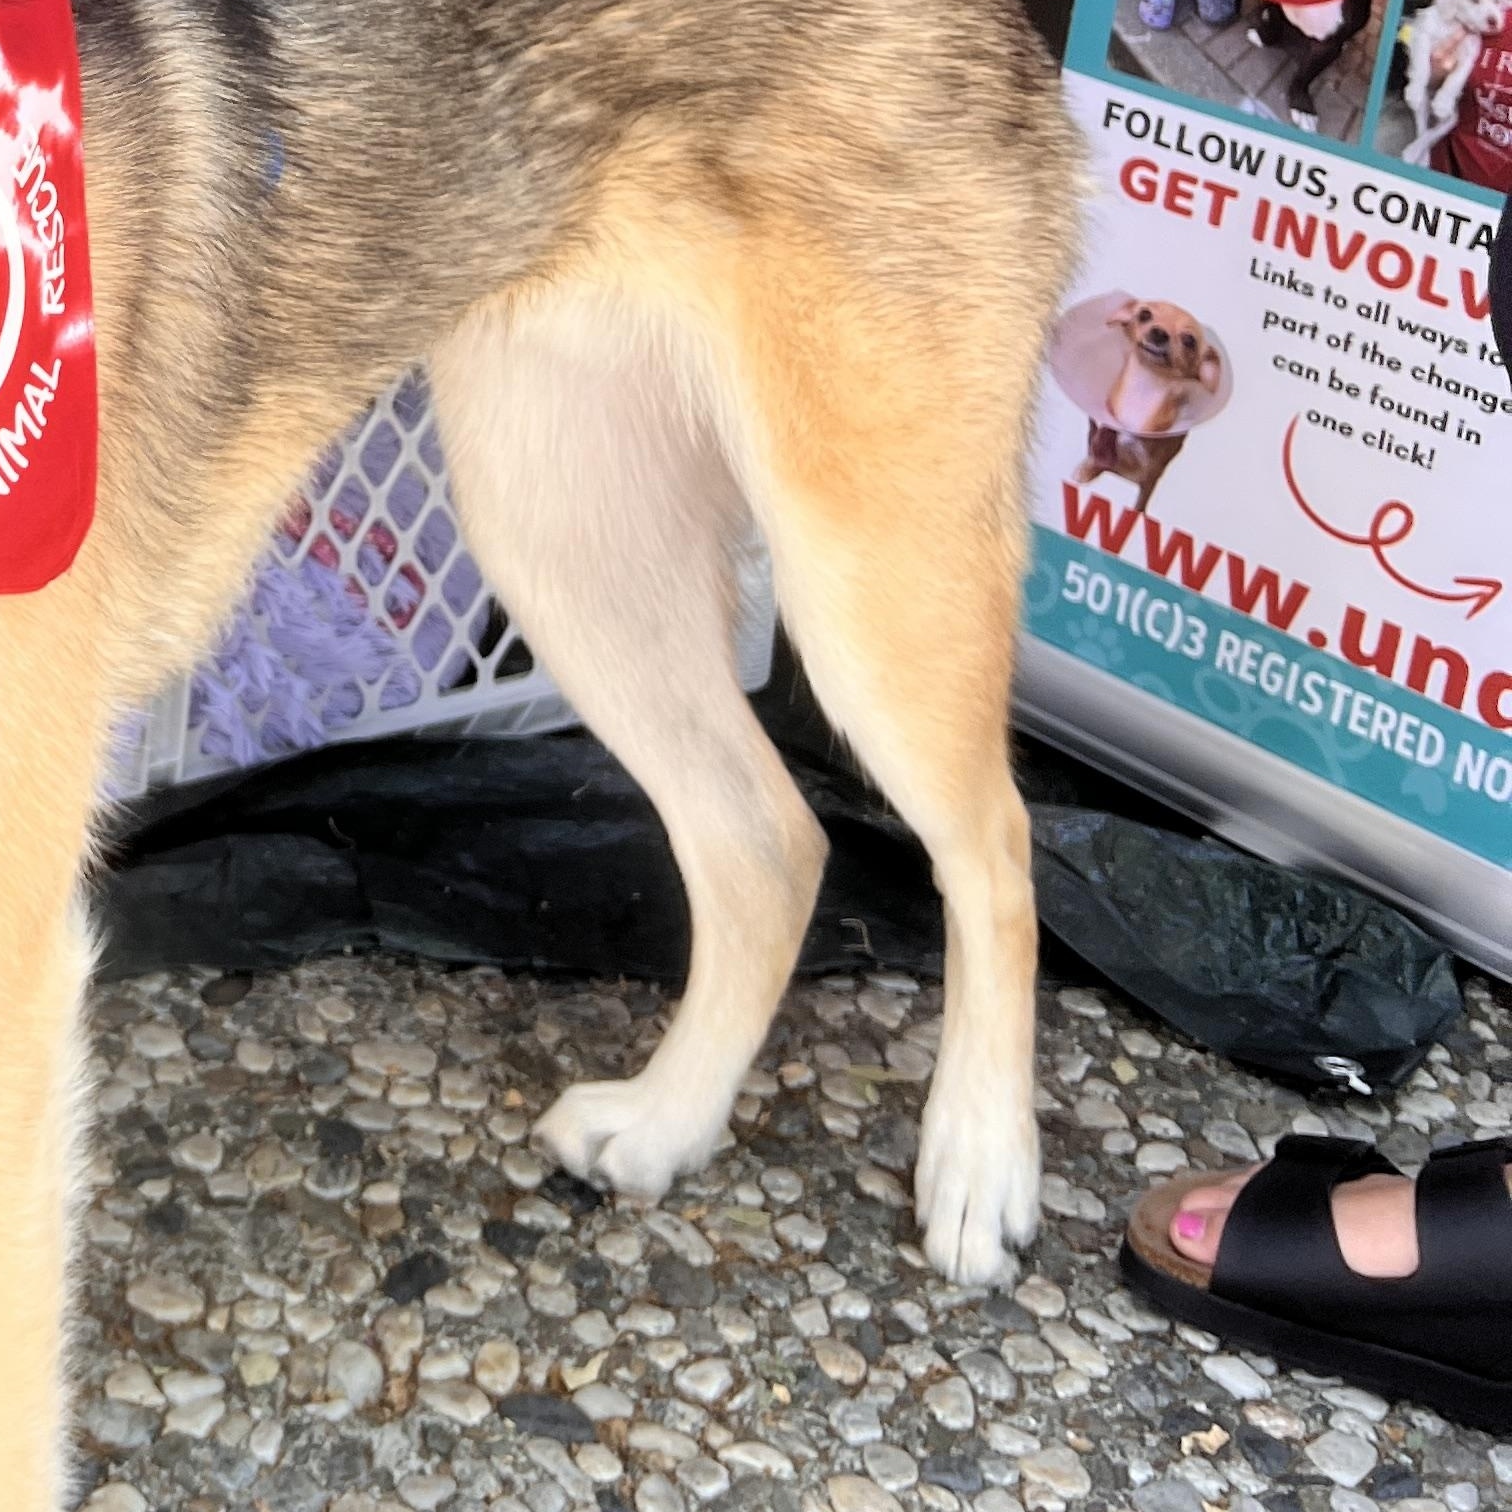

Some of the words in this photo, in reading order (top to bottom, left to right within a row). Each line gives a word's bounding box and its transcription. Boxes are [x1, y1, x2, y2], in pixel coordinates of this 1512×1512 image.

[1102, 99, 1266, 177] FOLLOW
[1275, 154, 1339, 211] US,
[1118, 157, 1238, 228] GET
[10, 120, 66, 316] RESCUE
[1249, 256, 1315, 298] Links
[1323, 285, 1348, 309] to
[1356, 300, 1391, 325] all
[1397, 315, 1468, 355] ways
[1262, 308, 1319, 340] part
[1326, 332, 1353, 354] of
[1360, 340, 1403, 372] the
[1272, 353, 1320, 384] can
[1327, 366, 1361, 398] be
[1369, 383, 1449, 433] found
[1456, 417, 1481, 446] in
[1306, 408, 1354, 437] one
[1361, 427, 1436, 471] click!
[1062, 559, 1208, 660] 501(C)3
[1215, 629, 1446, 768] REGISTERED
